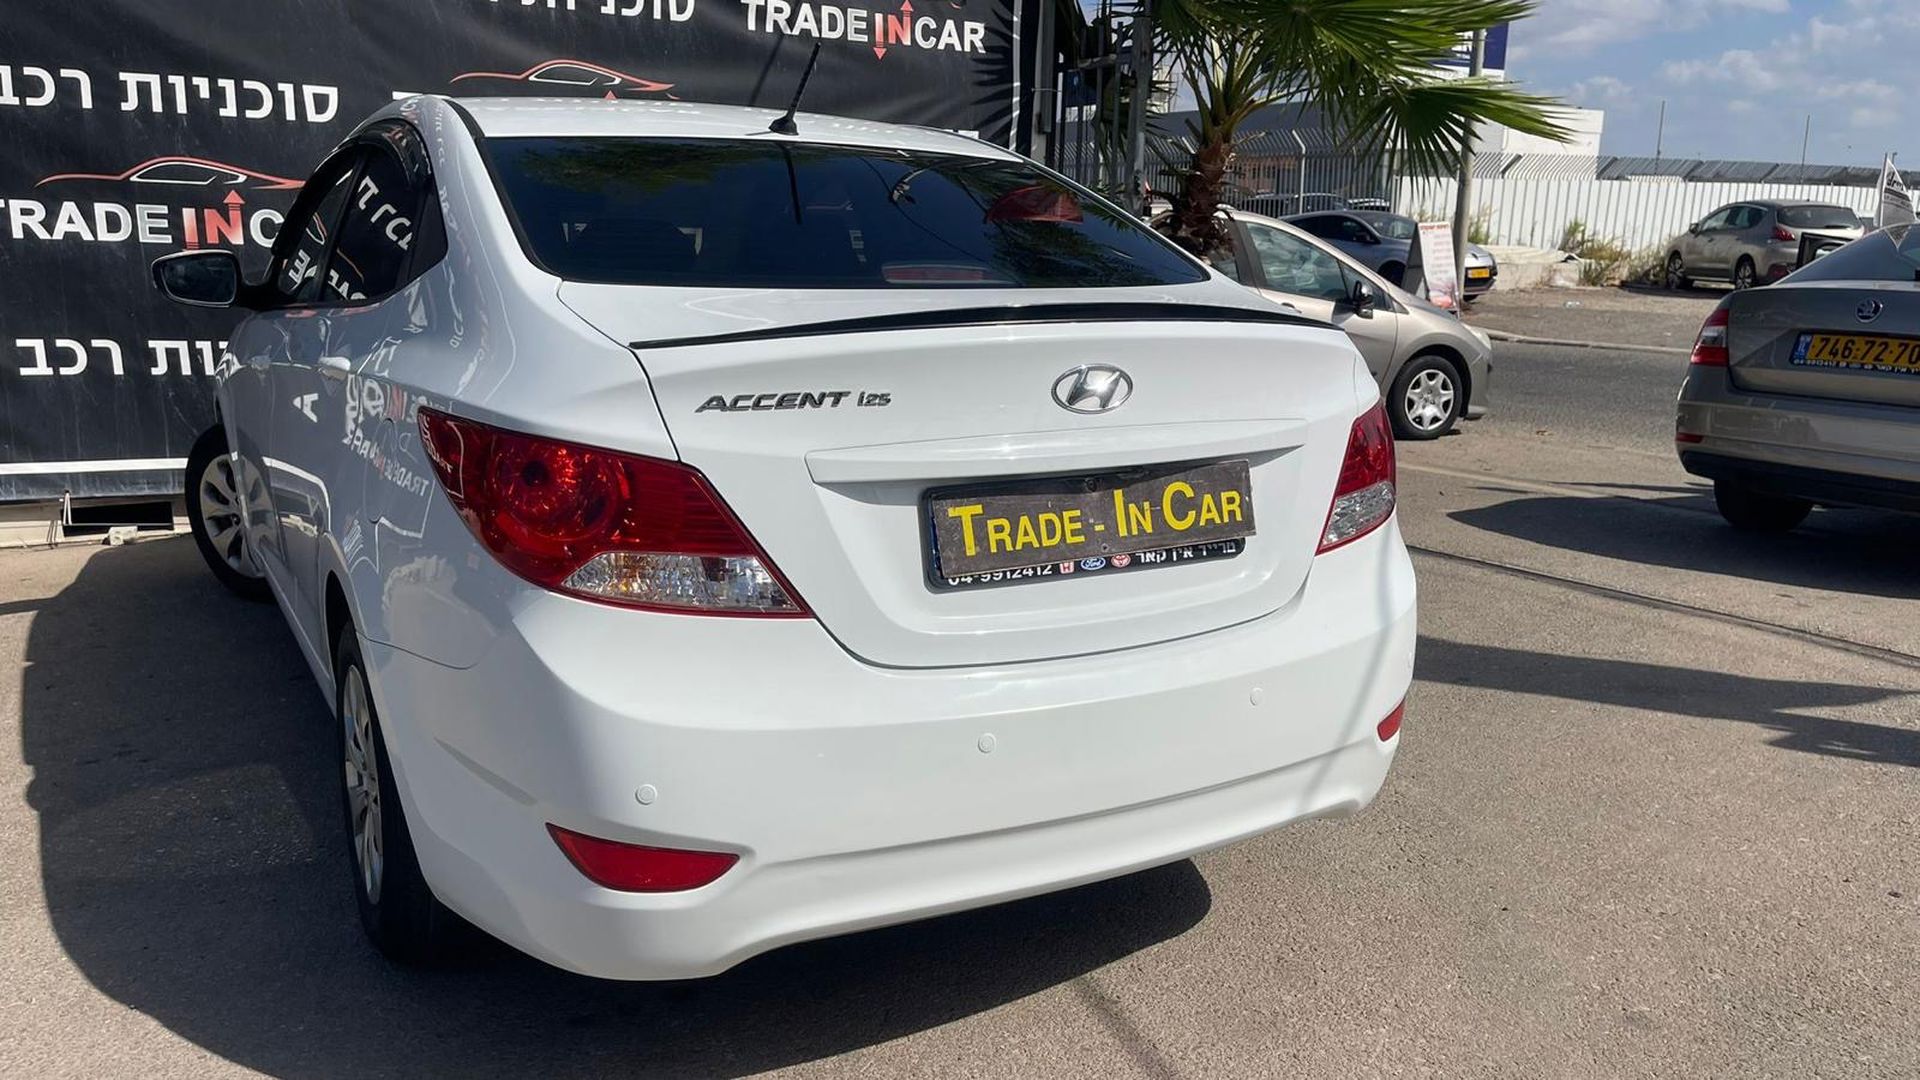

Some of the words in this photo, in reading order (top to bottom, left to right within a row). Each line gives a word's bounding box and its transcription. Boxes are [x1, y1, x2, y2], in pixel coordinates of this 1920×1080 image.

[118, 71, 339, 123] סוכניות
[15, 338, 125, 376] רכב
[694, 391, 852, 413] ACCENT
[947, 504, 1086, 557] TRADE
[1161, 480, 1243, 532] CAR
[1135, 551, 1167, 564] קאר
